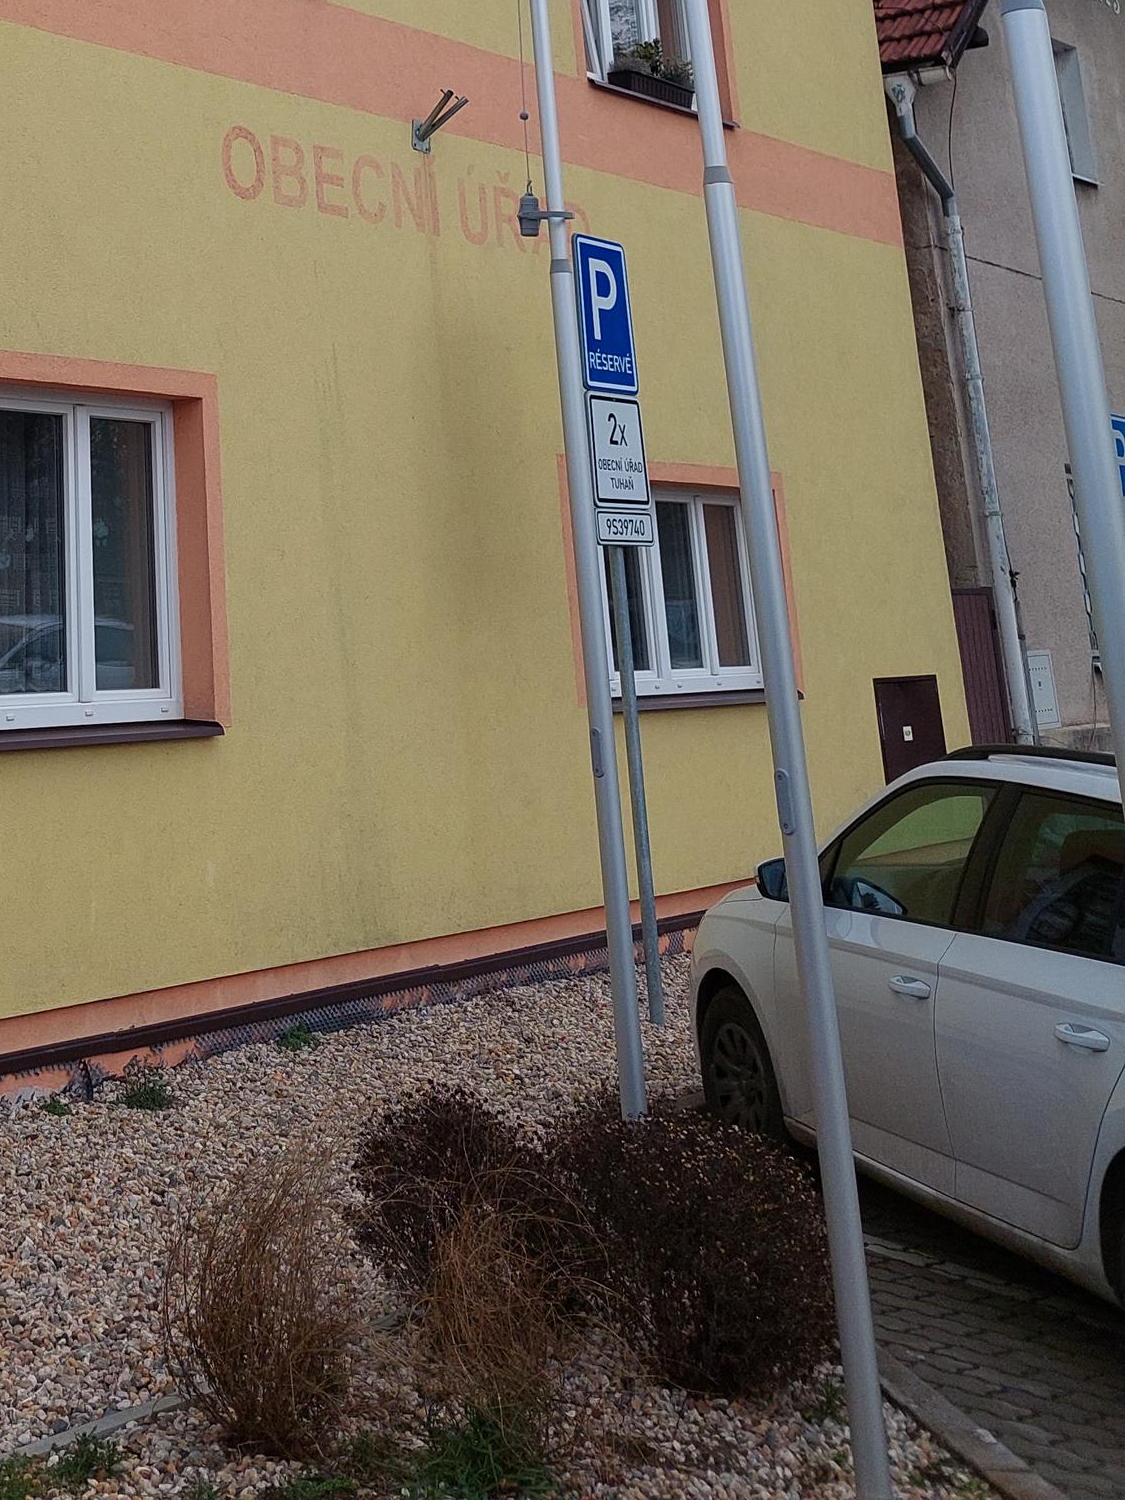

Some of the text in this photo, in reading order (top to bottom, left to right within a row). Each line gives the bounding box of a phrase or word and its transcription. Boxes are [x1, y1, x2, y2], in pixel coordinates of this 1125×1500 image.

[222, 125, 441, 237] OBECNÍ
[588, 257, 617, 340] P
[589, 349, 632, 374] RÉSERVÉ
[598, 457, 643, 474] OBECNÍ ÚŘAD
[610, 476, 634, 491] TUHAŇ
[606, 518, 645, 536] 9S39740
